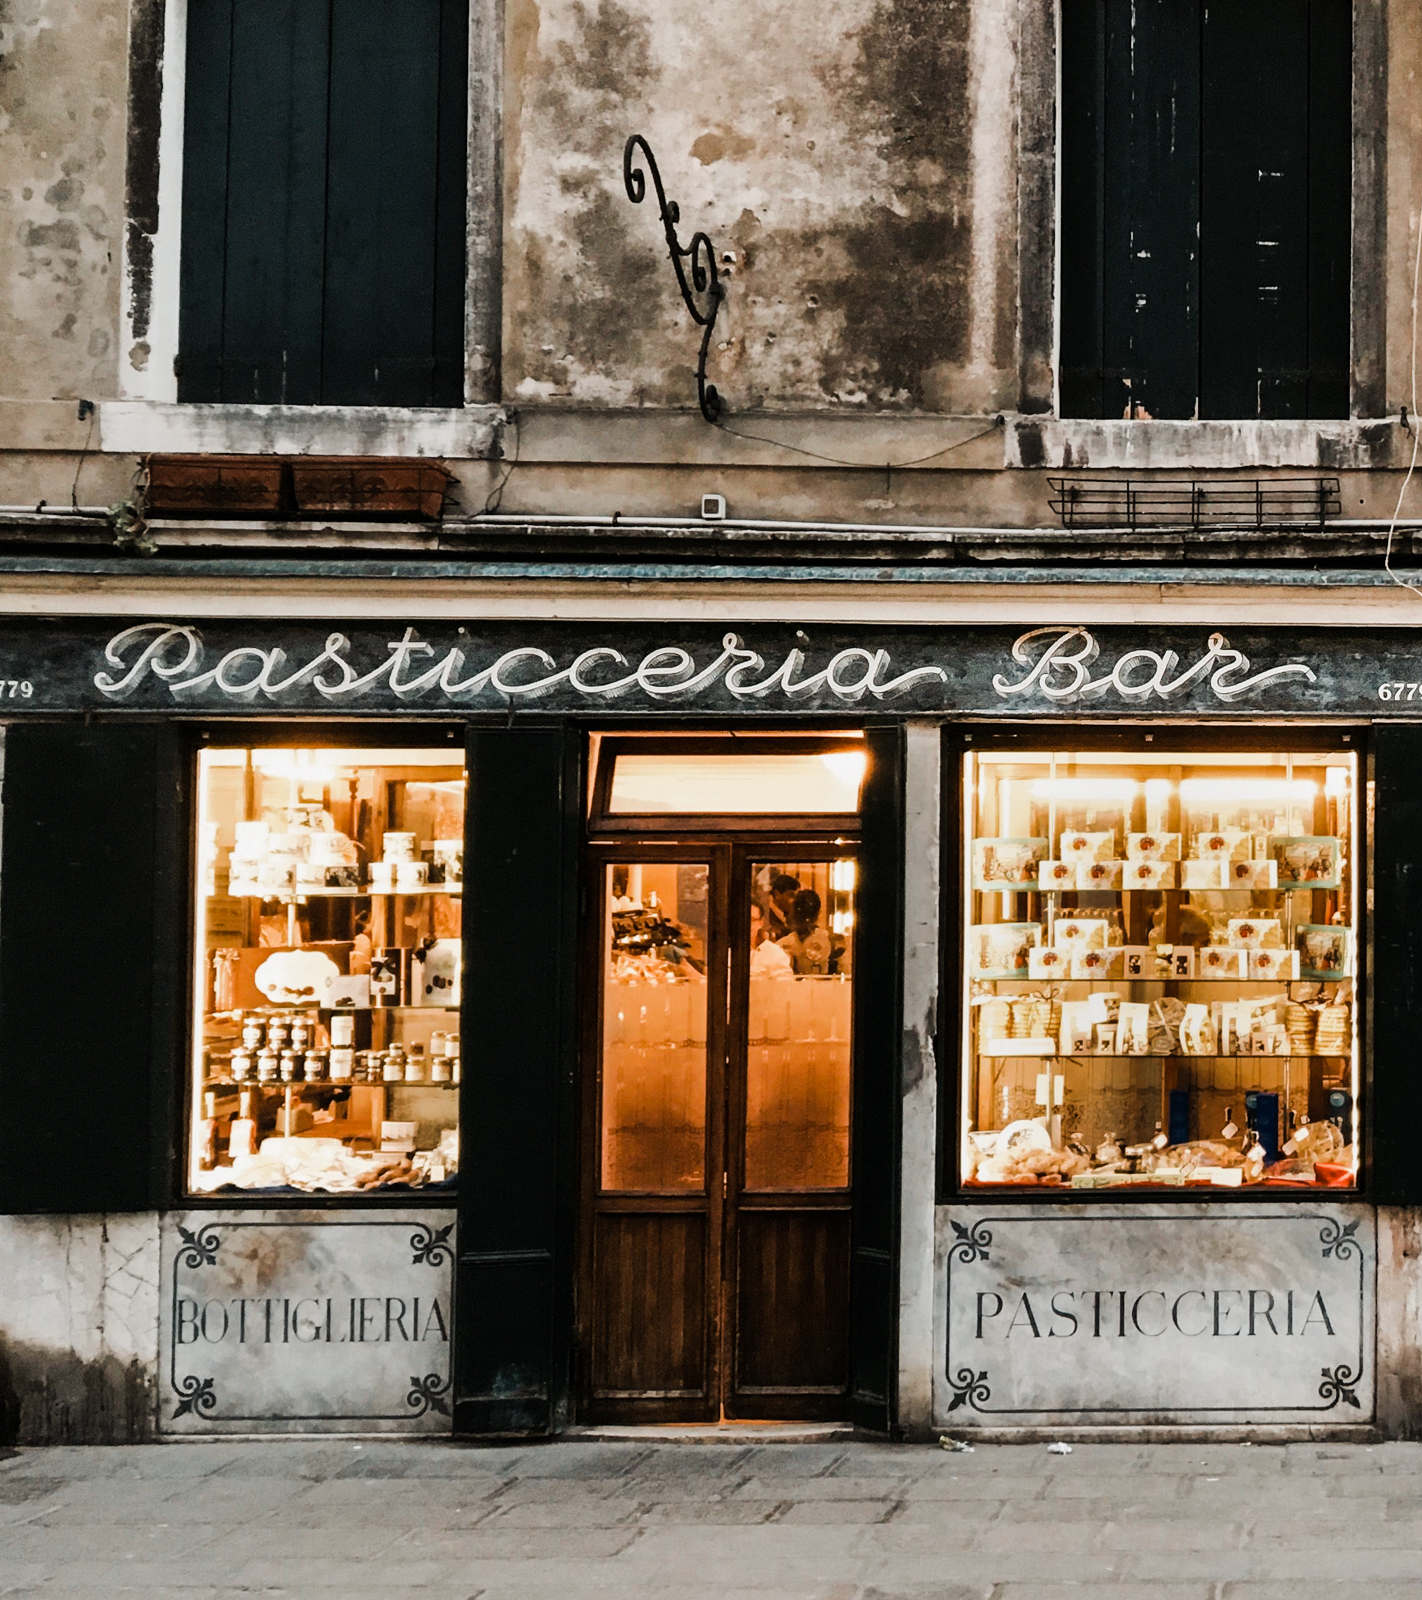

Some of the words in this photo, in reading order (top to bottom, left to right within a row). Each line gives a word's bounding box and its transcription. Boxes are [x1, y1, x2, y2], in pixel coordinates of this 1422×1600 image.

[94, 622, 949, 701] Pasticceria
[992, 625, 1317, 702] Bar
[176, 1296, 450, 1345] BOTTIGLIERIA
[974, 1289, 1336, 1340] PASTICCERIA
